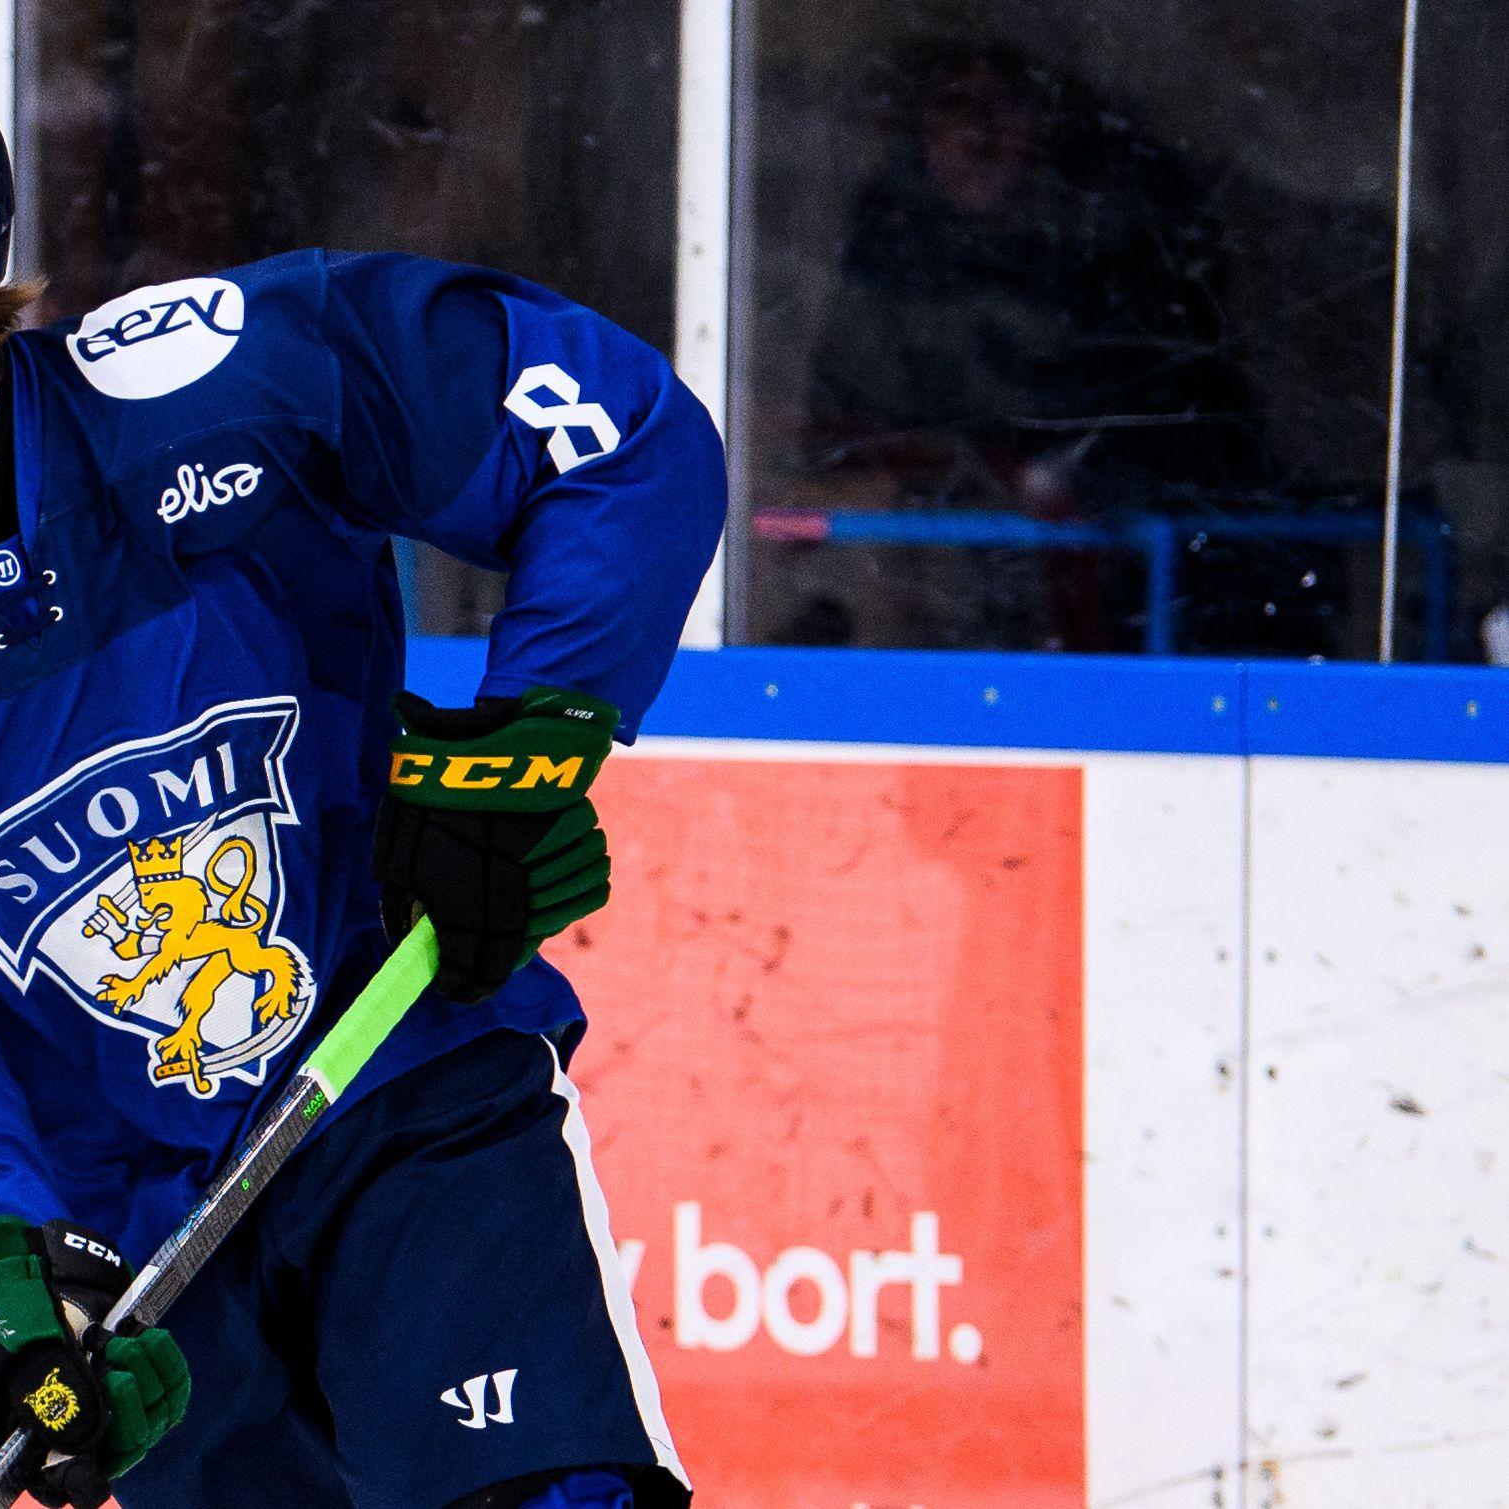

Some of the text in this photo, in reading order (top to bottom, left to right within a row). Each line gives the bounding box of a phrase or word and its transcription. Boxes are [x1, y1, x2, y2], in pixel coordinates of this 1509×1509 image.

[76, 288, 242, 363] eezy
[503, 363, 621, 474] 8
[156, 463, 264, 524] elisa
[390, 752, 584, 789] CCM
[63, 1231, 121, 1268] CCM
[673, 1201, 984, 1364] bort.
